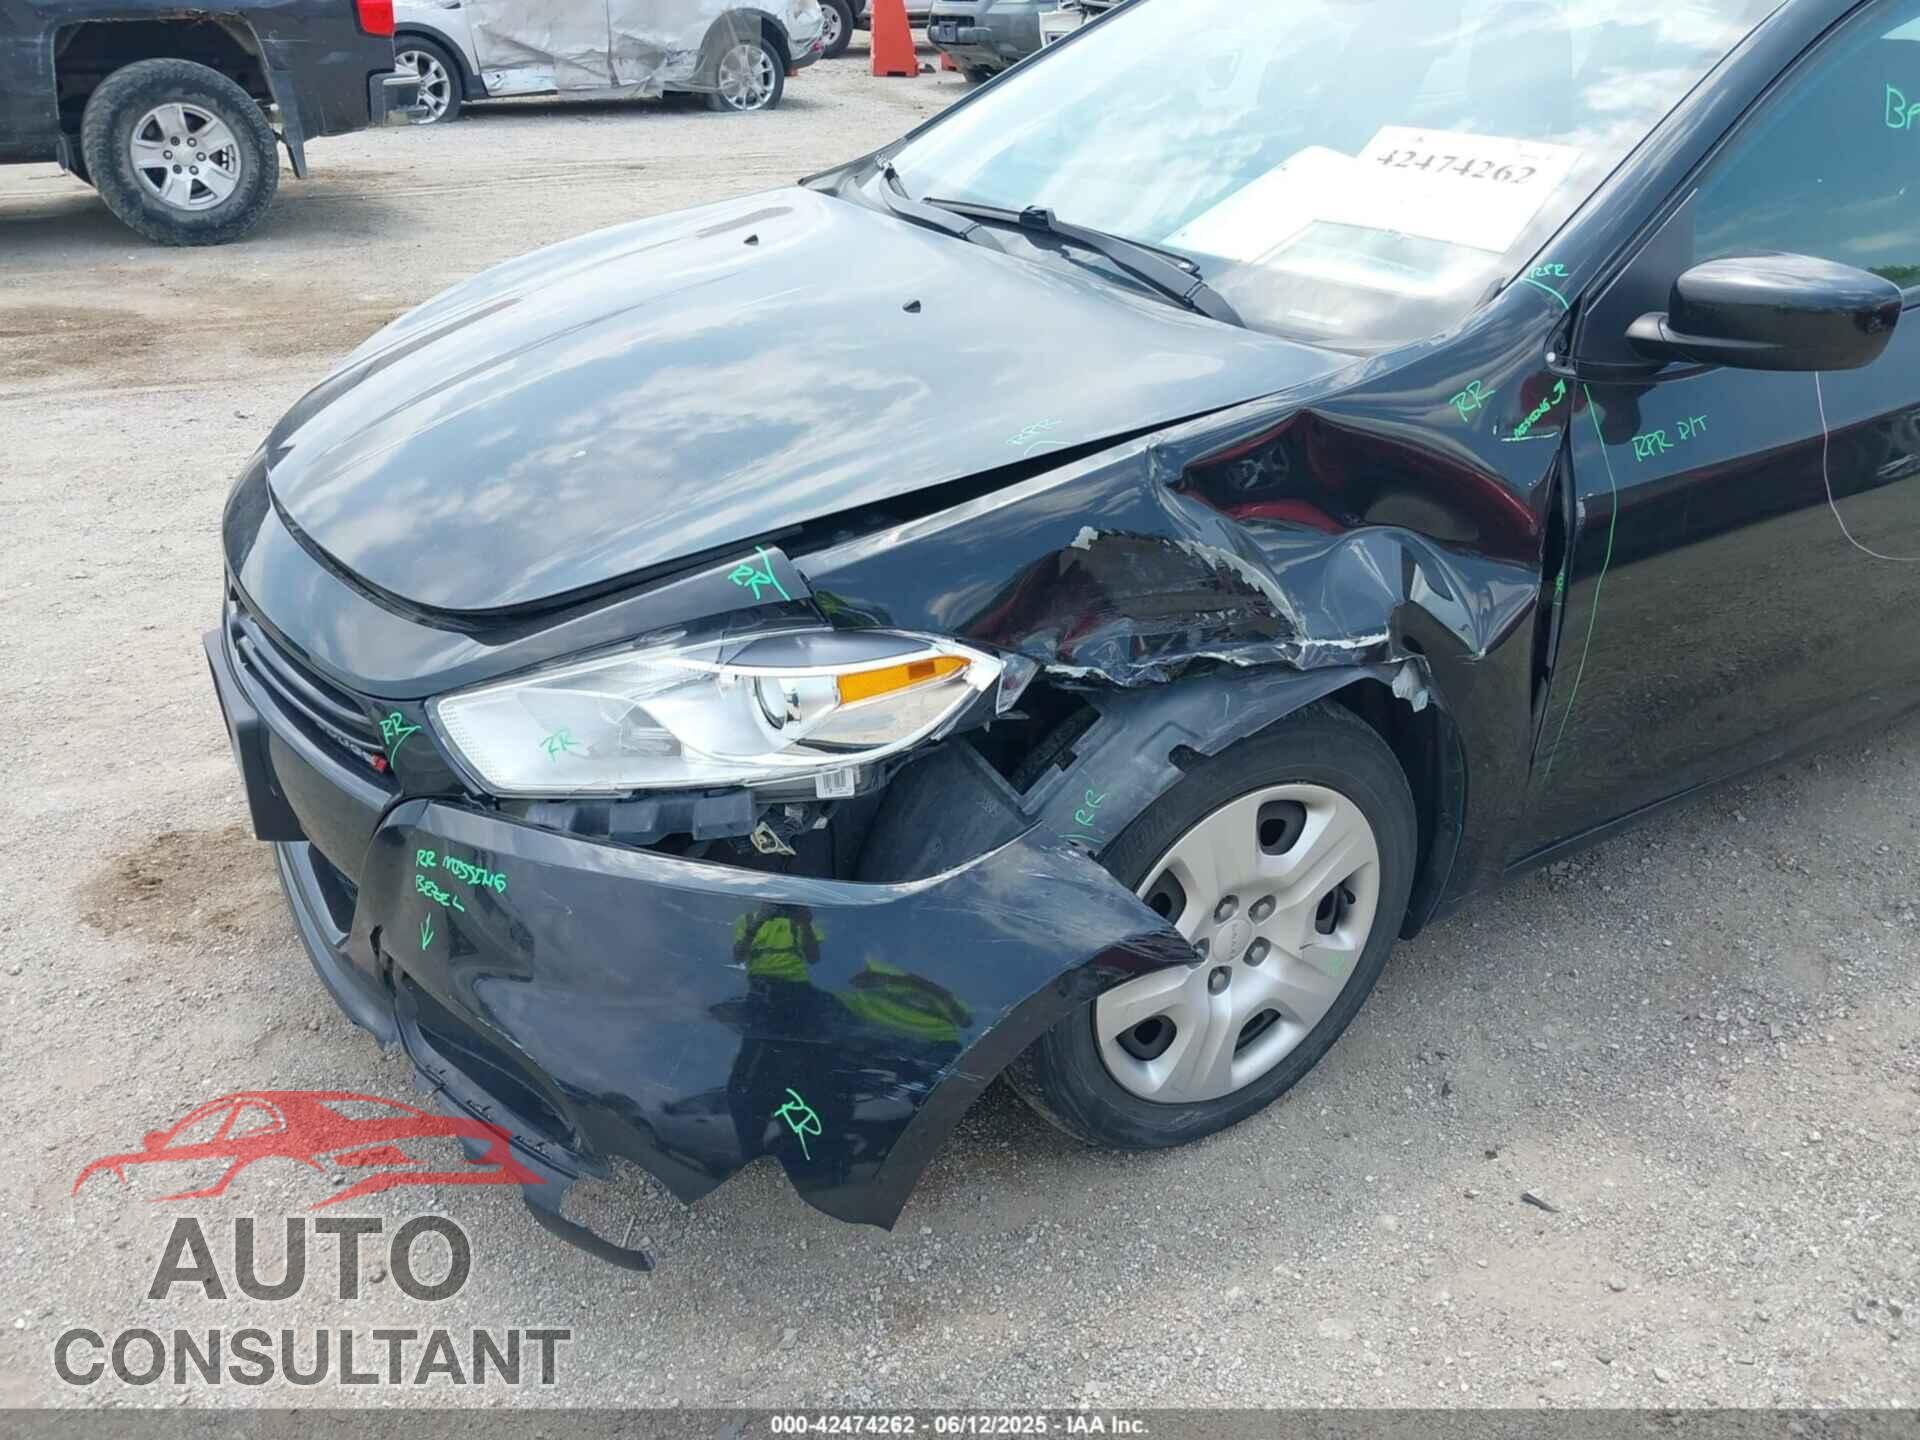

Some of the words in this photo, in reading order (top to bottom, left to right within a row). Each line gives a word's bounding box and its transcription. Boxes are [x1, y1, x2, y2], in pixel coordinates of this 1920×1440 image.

[1376, 149, 1537, 184] 42474262
[1450, 380, 1495, 422] RR
[1631, 429, 1675, 462] RPR
[379, 712, 421, 744] RR
[416, 849, 438, 868] RR
